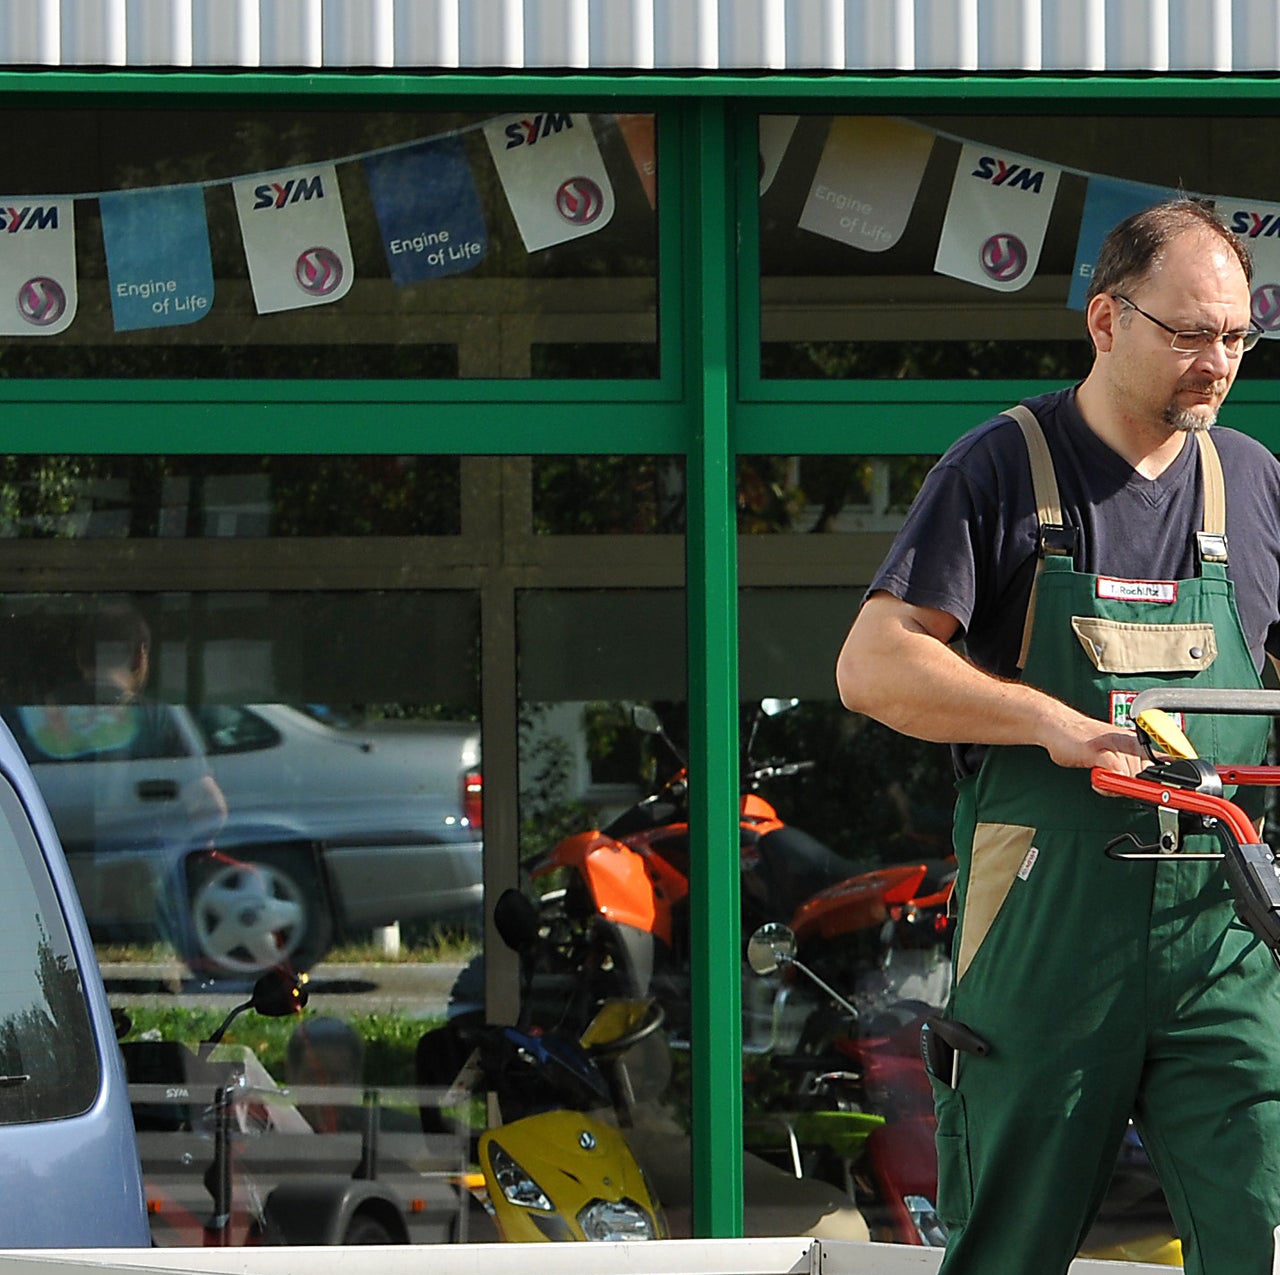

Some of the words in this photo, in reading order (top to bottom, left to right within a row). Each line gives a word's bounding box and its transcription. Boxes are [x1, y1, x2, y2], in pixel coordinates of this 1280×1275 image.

[505, 112, 574, 149] SYM
[971, 155, 1045, 194] SYM
[253, 175, 324, 209] SYM
[814, 185, 873, 215] Engine
[390, 229, 449, 255] Engine
[839, 215, 858, 234] of
[860, 222, 892, 243] Life
[427, 247, 445, 265] of
[449, 241, 481, 259] Life
[117, 279, 177, 298] Engine
[152, 298, 170, 314] of
[175, 295, 207, 312] Life
